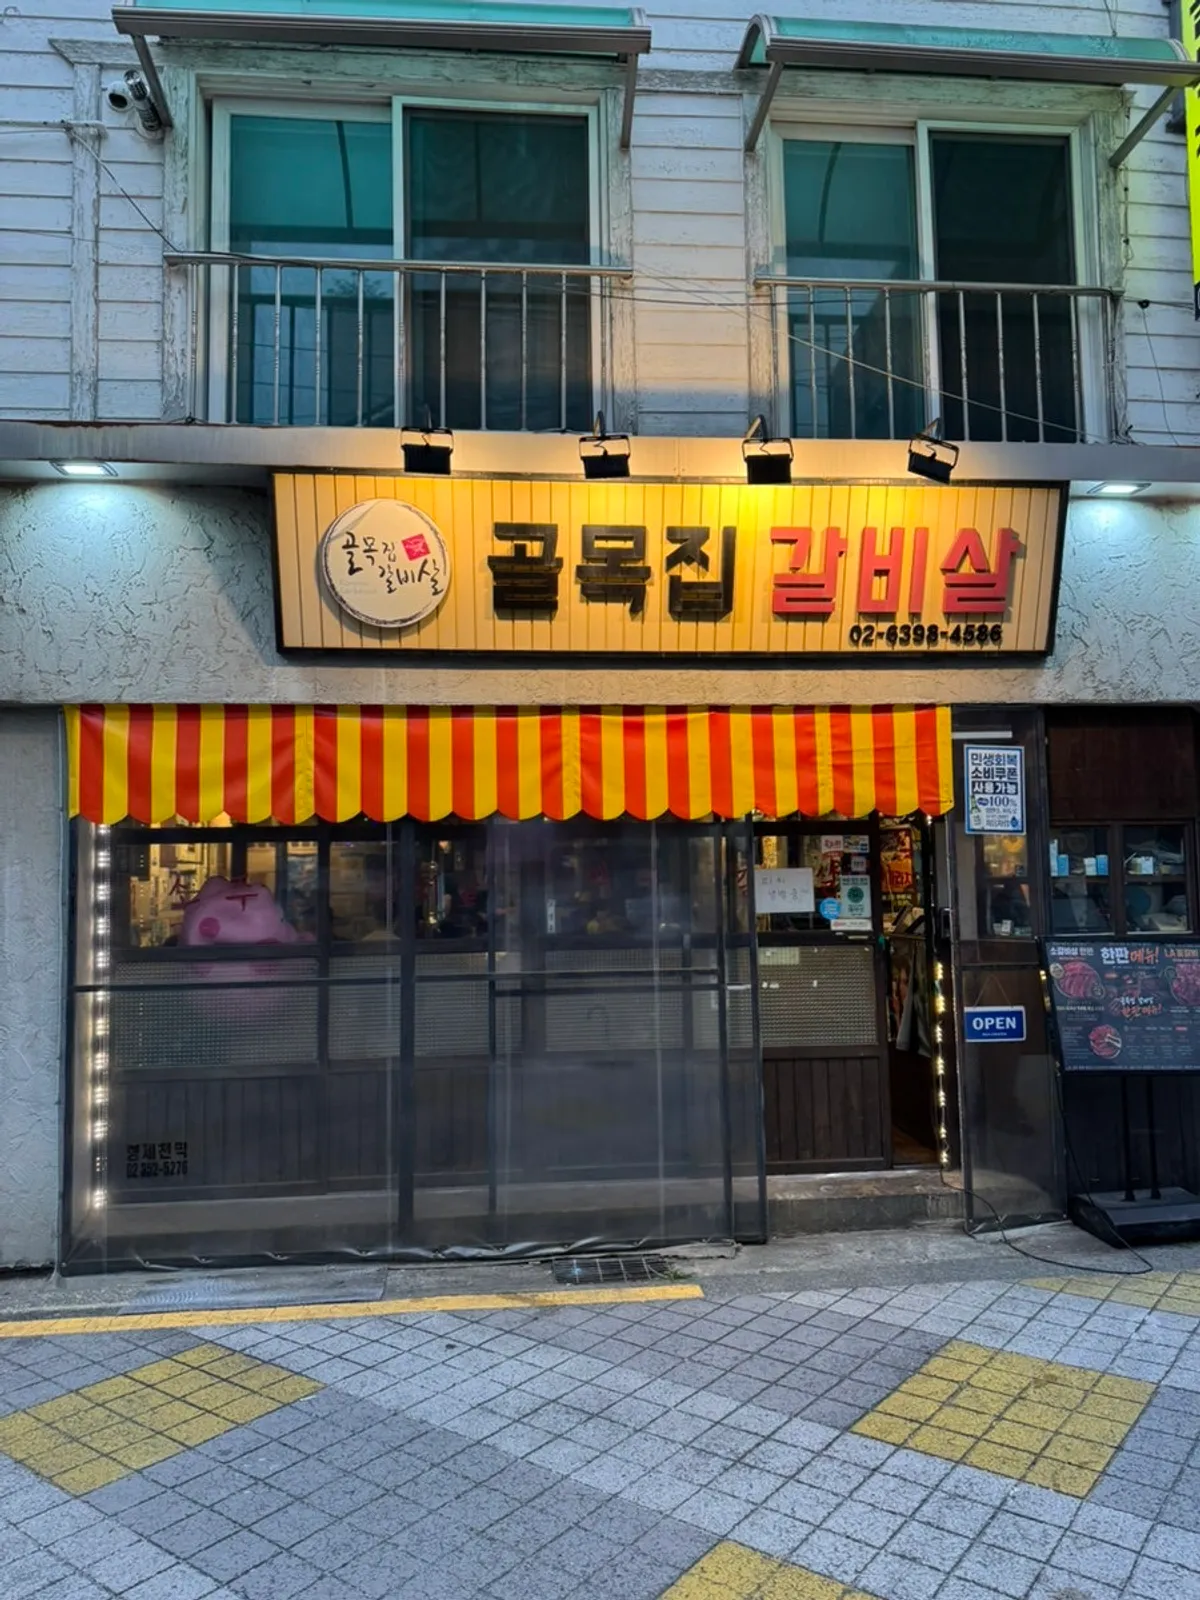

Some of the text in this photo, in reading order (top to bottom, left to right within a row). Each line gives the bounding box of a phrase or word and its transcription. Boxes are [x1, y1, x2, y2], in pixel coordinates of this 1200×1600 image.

[342, 532, 397, 576] 골목집
[378, 559, 444, 596] 갈비살
[487, 522, 1021, 621] 골목집 갈비살
[849, 623, 1003, 645] 02-6398-4586
[971, 767, 1018, 780] 소비쿠폰
[973, 781, 1017, 794] 사용가능
[972, 1016, 1017, 1031] OPEN
